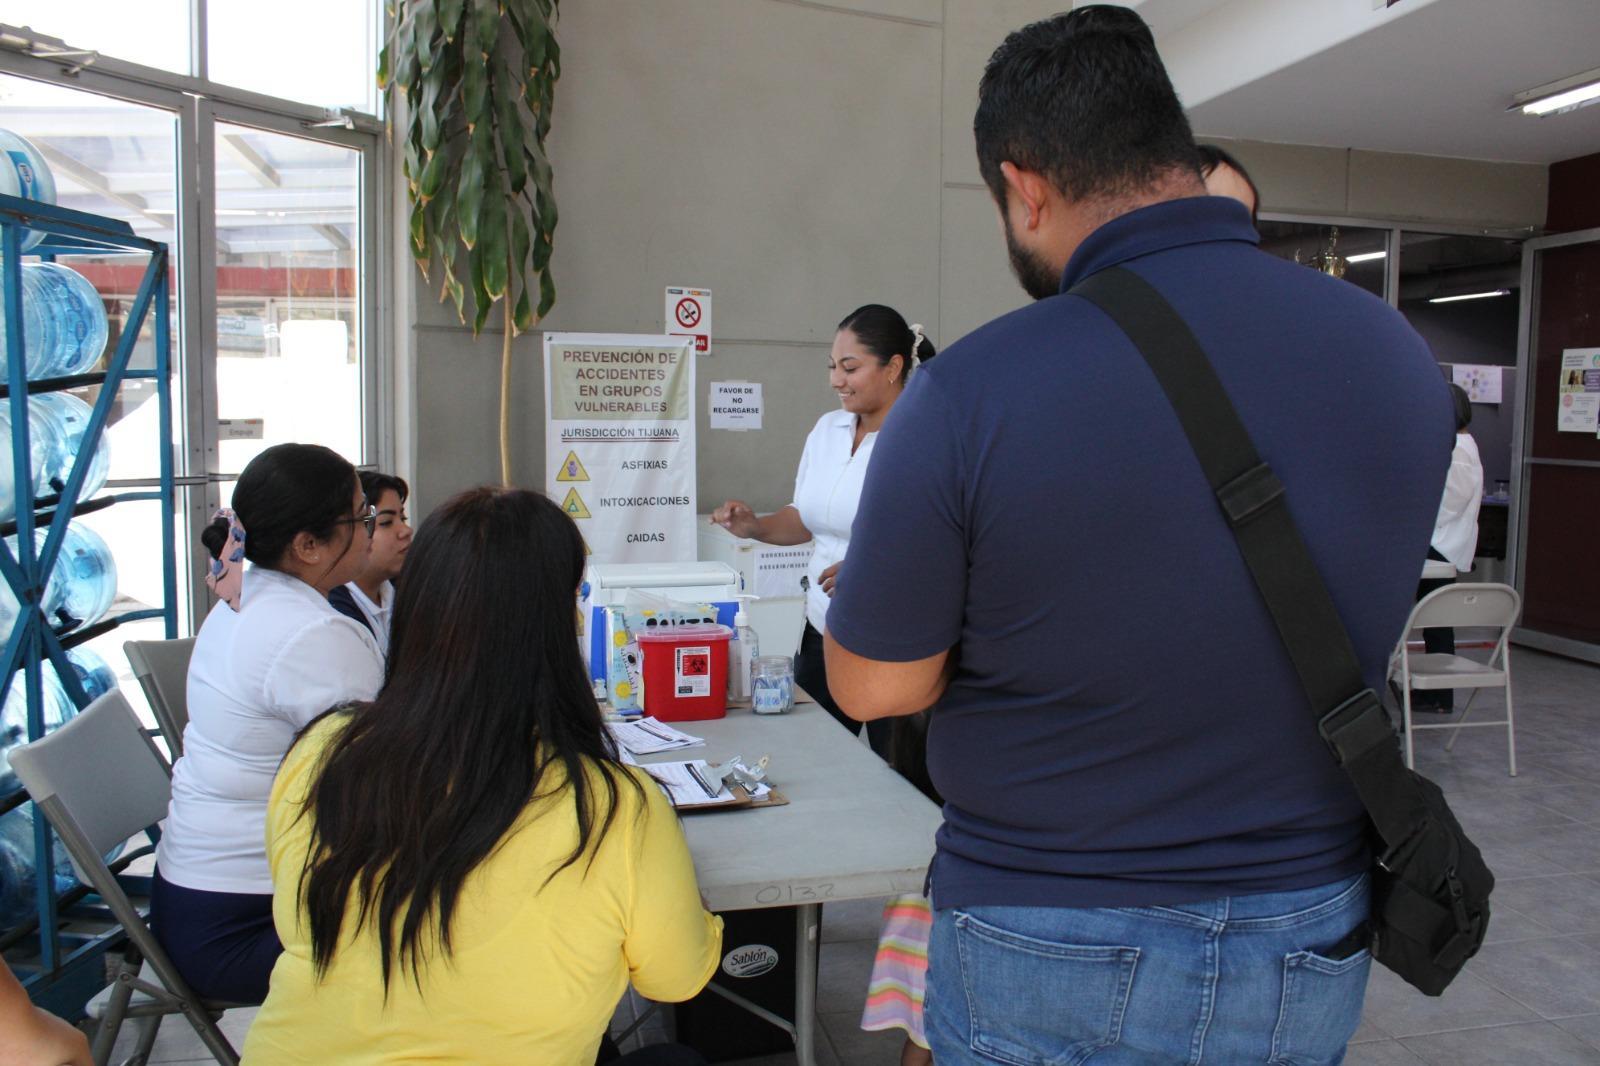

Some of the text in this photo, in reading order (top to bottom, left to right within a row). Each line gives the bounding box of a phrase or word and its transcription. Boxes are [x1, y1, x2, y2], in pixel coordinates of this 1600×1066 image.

[562, 350, 677, 364] PREVENCIÓN DE
[575, 368, 666, 381] ACCIDENTES
[579, 385, 662, 397] EN GRUPOS
[574, 401, 668, 412] VULNERABLES
[560, 426, 680, 438] JURISDICCIÓN TIJUANA
[621, 460, 669, 470] ASFIXIAS
[600, 496, 690, 508] INTOXICACIONES
[626, 532, 666, 543] CAIDAS
[730, 948, 767, 967] Sablón
